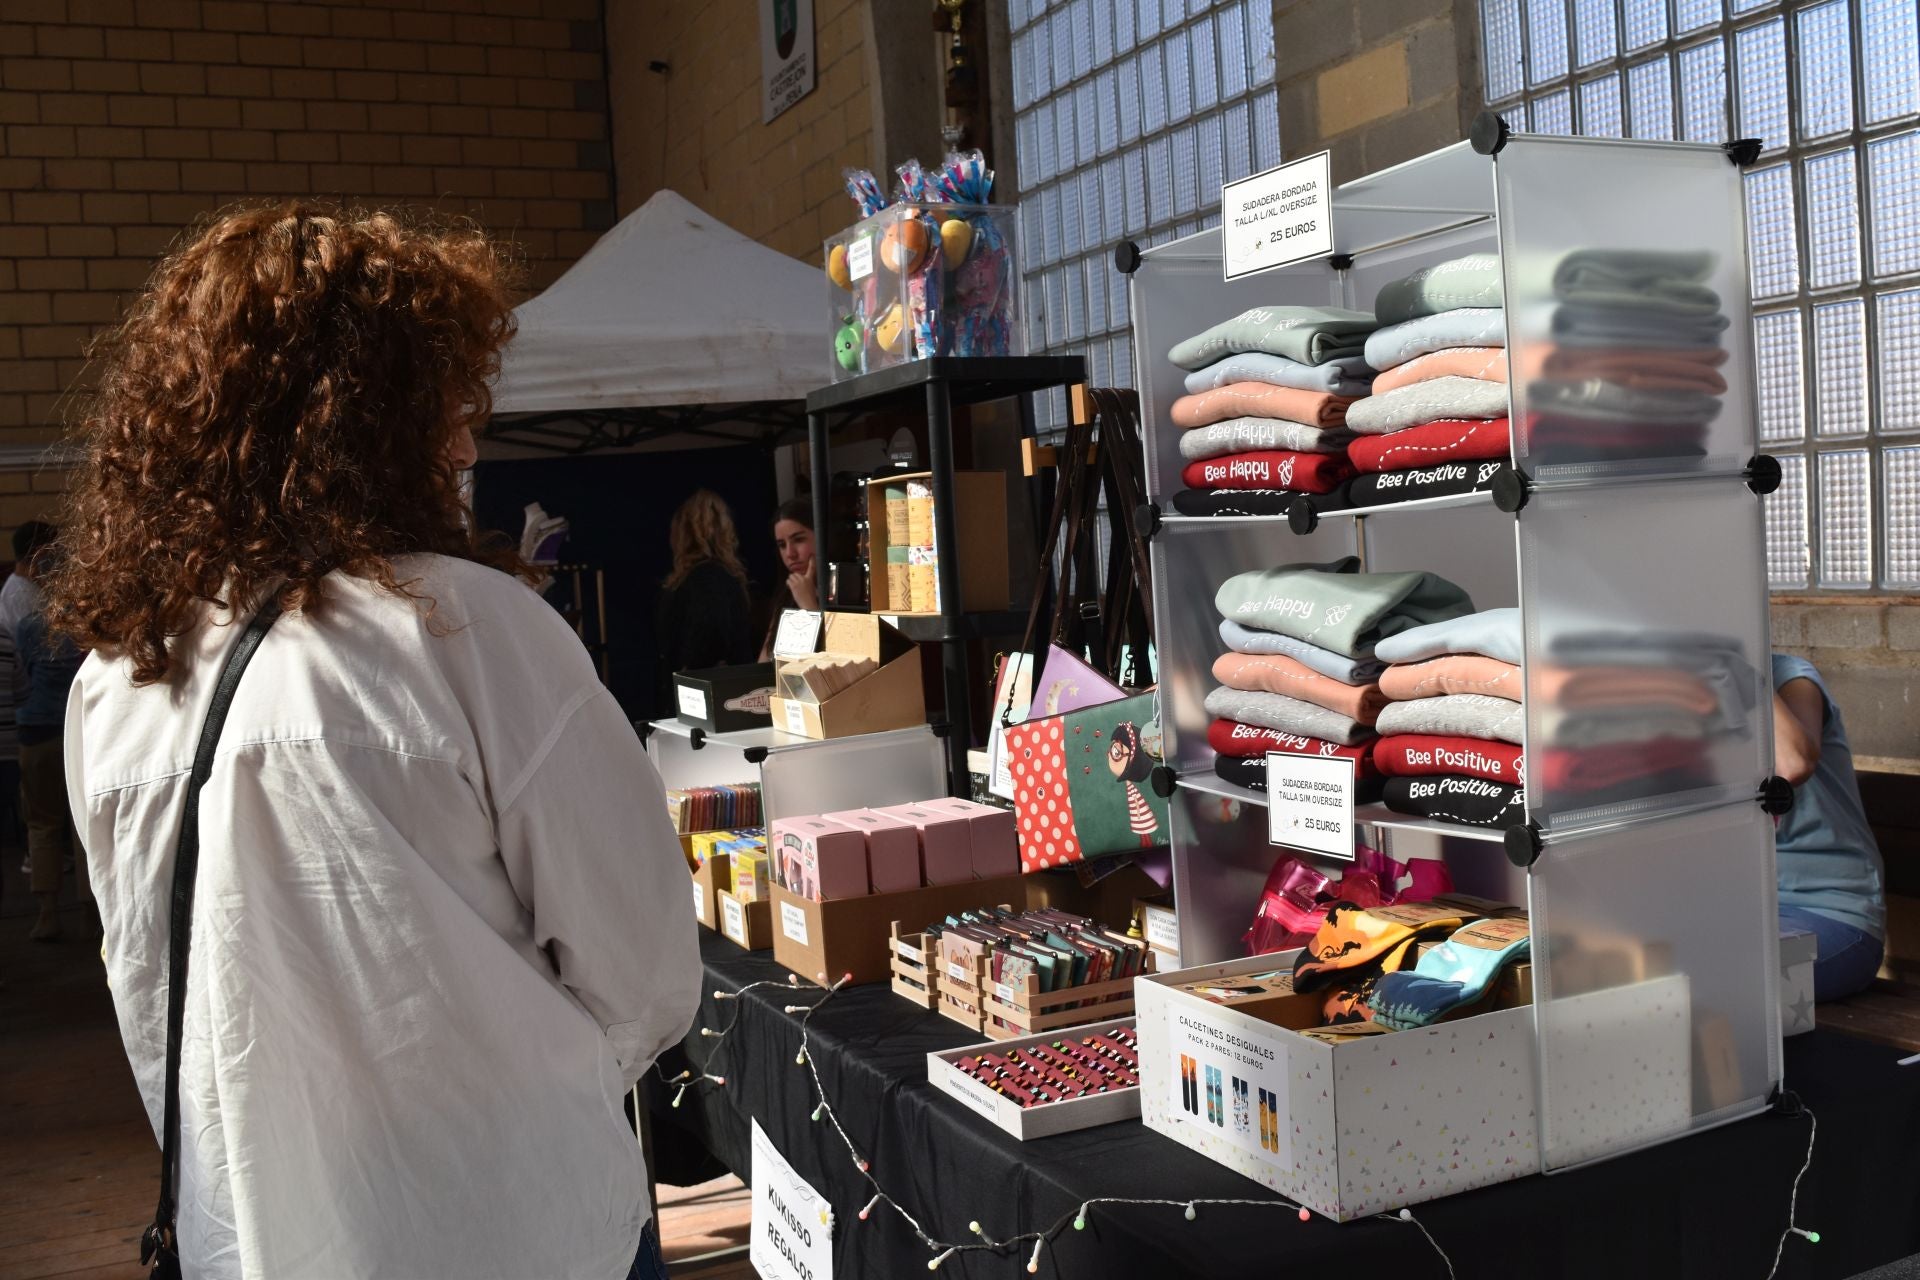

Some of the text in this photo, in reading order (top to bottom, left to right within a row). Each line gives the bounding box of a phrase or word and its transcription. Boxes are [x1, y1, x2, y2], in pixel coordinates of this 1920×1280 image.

[1242, 181, 1317, 212] SUDADERA BORDADA
[1234, 194, 1318, 228] TALLA L/XL OVERSIZE
[1270, 220, 1317, 243] 25 EUROS
[1207, 421, 1275, 444] Bee Happy
[1204, 459, 1270, 482] Bee Happy
[1376, 464, 1467, 489] Bee Positive
[1236, 594, 1316, 619] Bee Happy
[740, 695, 767, 708] METAL
[1231, 724, 1310, 749] Bee Happy
[1404, 747, 1502, 774] Bee Positive
[1282, 778, 1343, 793] SUDADERA BORDADA
[1409, 778, 1503, 799] Bee Positive
[1278, 790, 1298, 801] TALLA
[1312, 796, 1343, 808] OVERSIZE
[1304, 817, 1341, 833] 25 EUROS
[1179, 1015, 1275, 1060] CALCETINES DESIGUALES
[1188, 1033, 1264, 1070] PACK 2 PARES: 12 EUROS
[768, 1184, 812, 1248] KUKISSO
